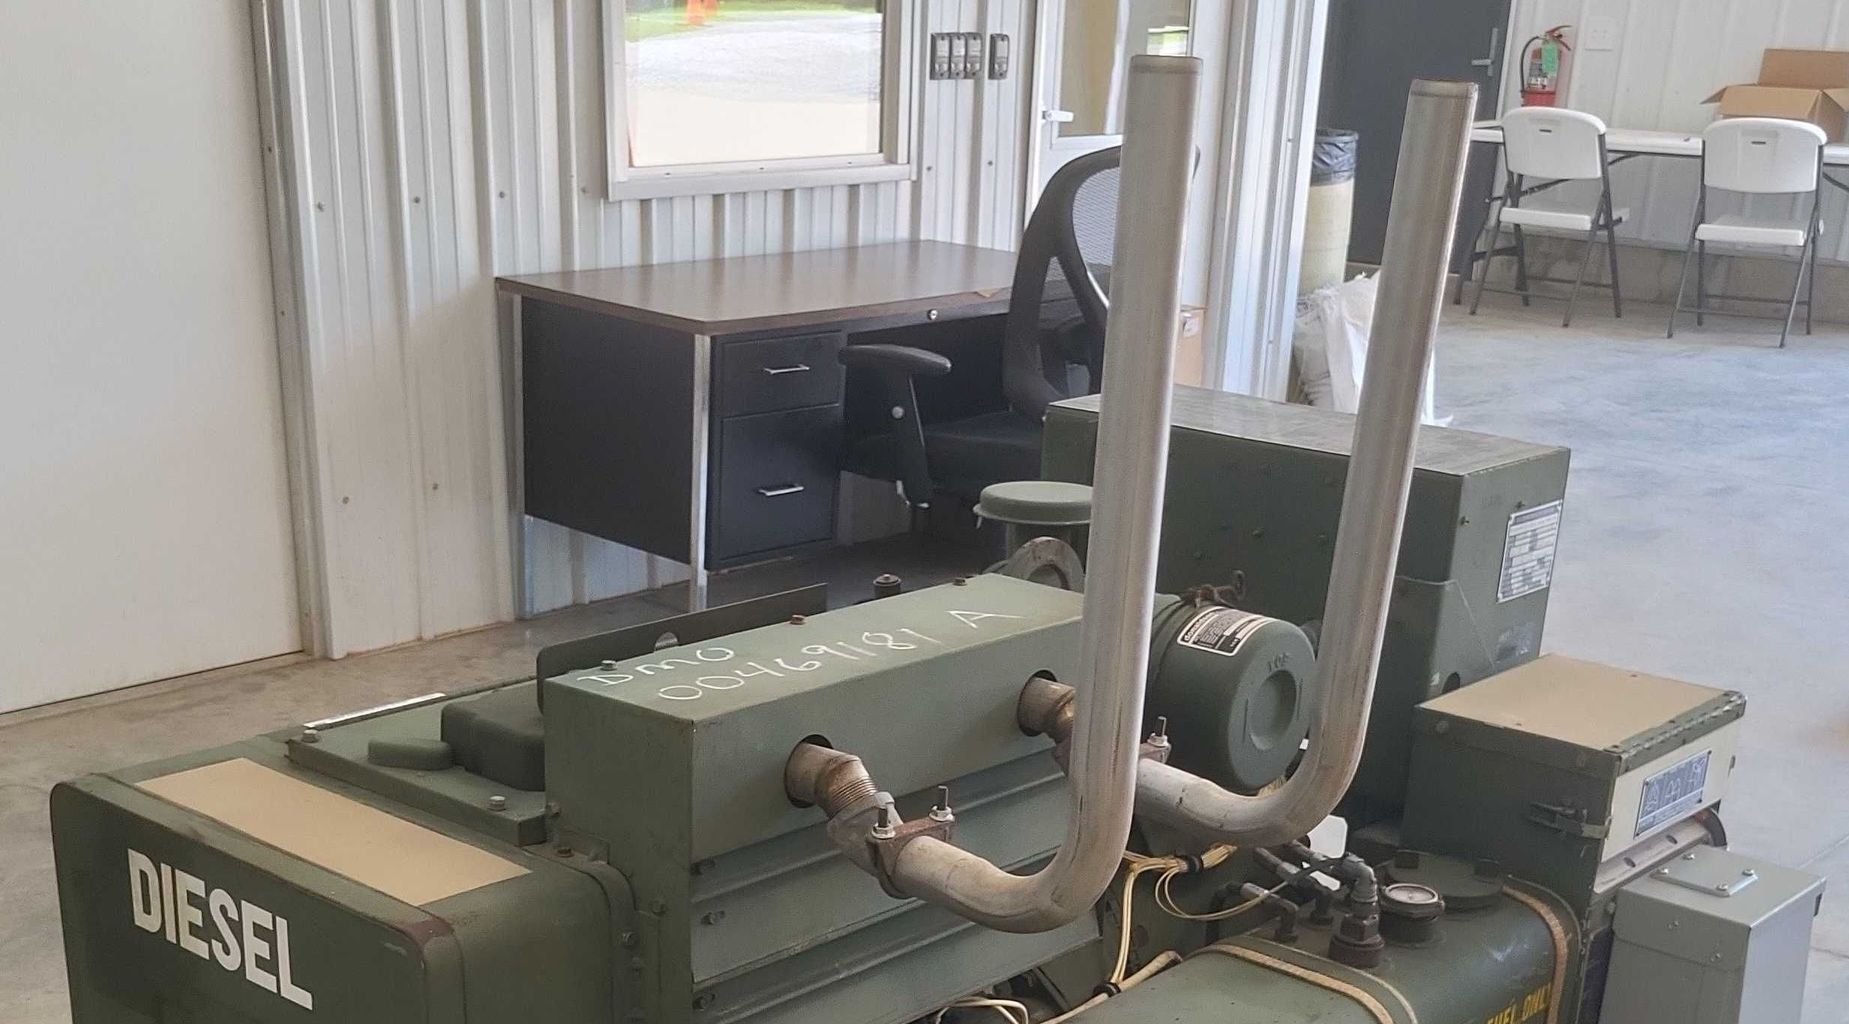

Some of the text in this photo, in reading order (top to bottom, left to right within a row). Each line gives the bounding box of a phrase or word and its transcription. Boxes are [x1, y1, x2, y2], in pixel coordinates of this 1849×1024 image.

[947, 609, 1027, 628] A
[127, 847, 313, 1011] DIESEL
[1522, 984, 1552, 1021] ONL
